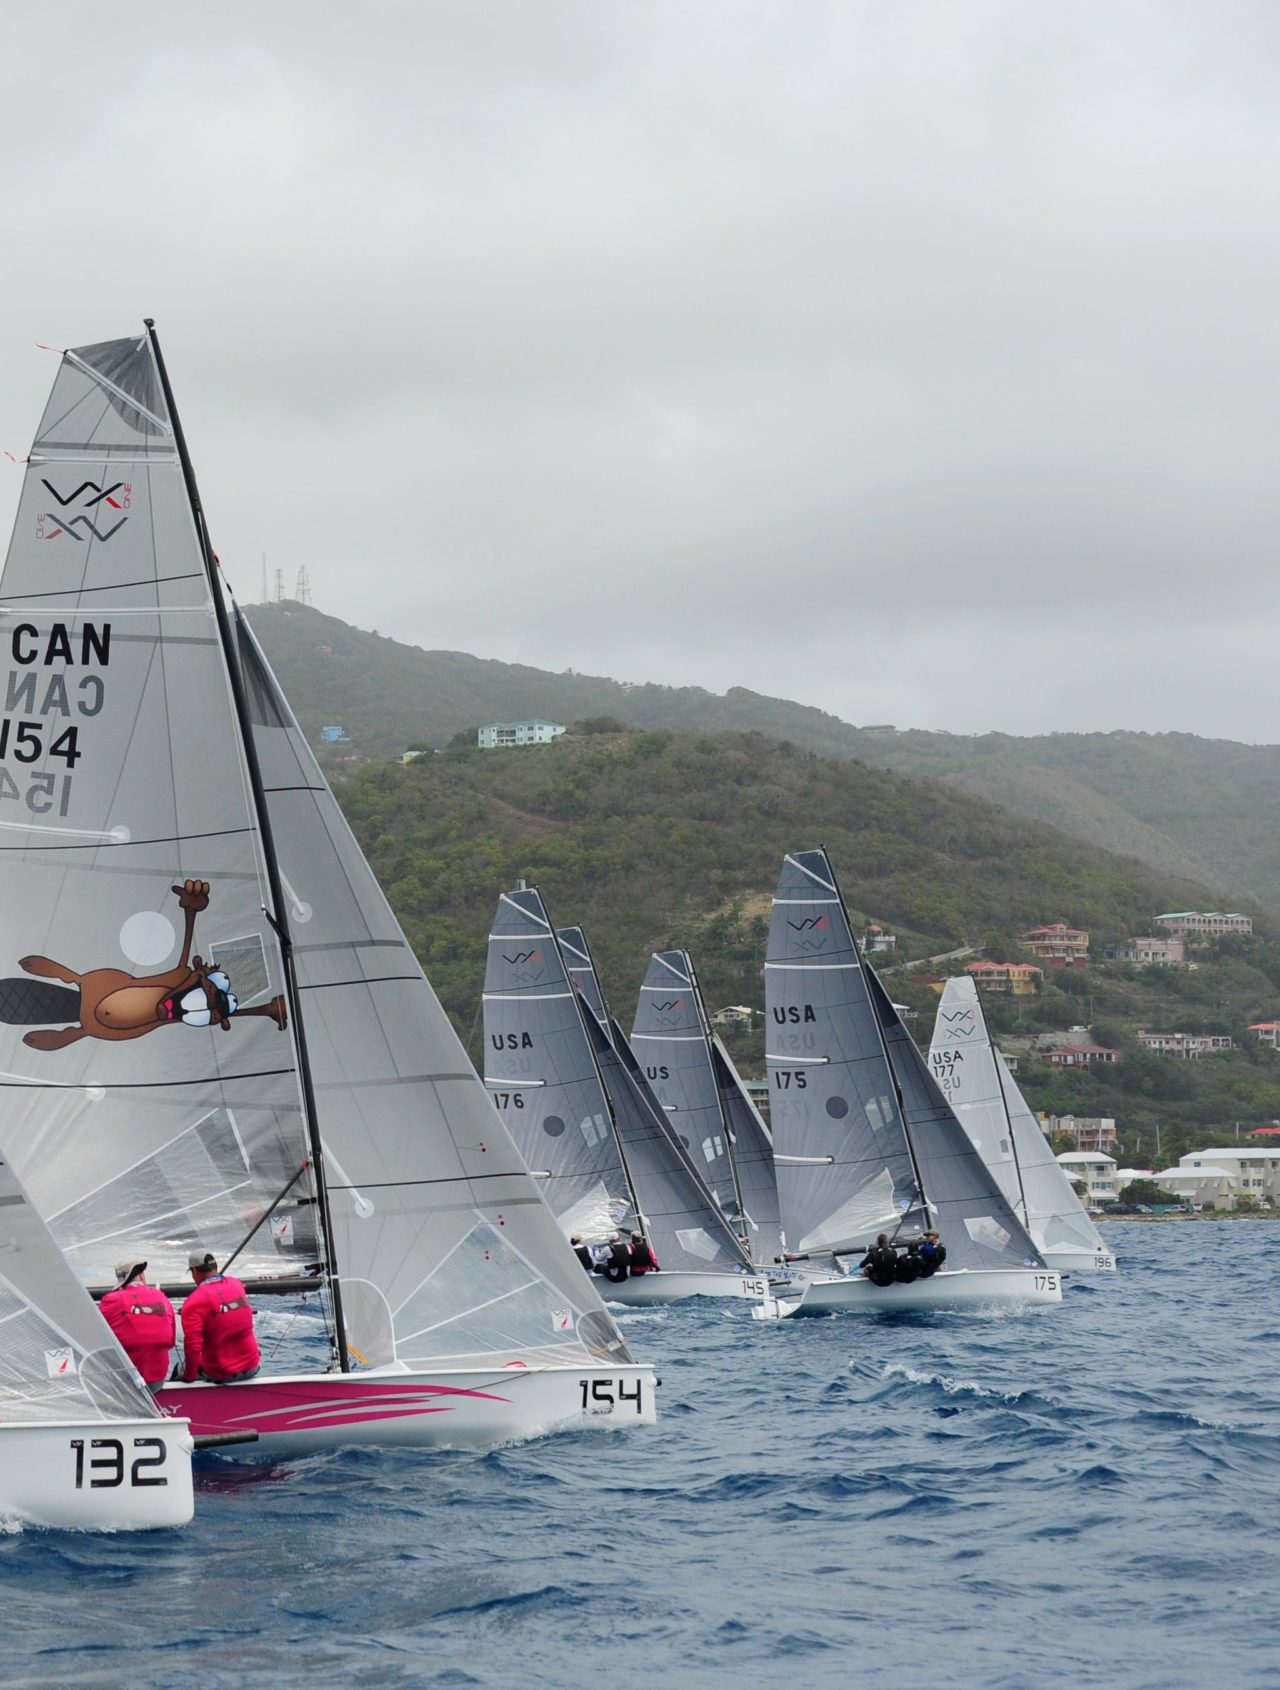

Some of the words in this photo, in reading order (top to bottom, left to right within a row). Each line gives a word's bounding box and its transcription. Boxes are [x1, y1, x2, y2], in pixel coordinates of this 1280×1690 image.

[41, 479, 124, 509] VX
[123, 482, 132, 509] ONE
[11, 622, 111, 667] CAN
[773, 1004, 817, 1025] USA
[492, 1031, 534, 1051] USA
[933, 1050, 964, 1065] USA
[647, 1066, 669, 1080] US
[933, 1064, 954, 1078] 177
[775, 1071, 808, 1090] 175
[494, 1092, 525, 1110] 176
[1094, 1257, 1112, 1268] 196
[742, 1280, 765, 1295] 145
[1034, 1276, 1057, 1291] 175
[579, 1379, 642, 1415] 154
[70, 1437, 168, 1489] 132
